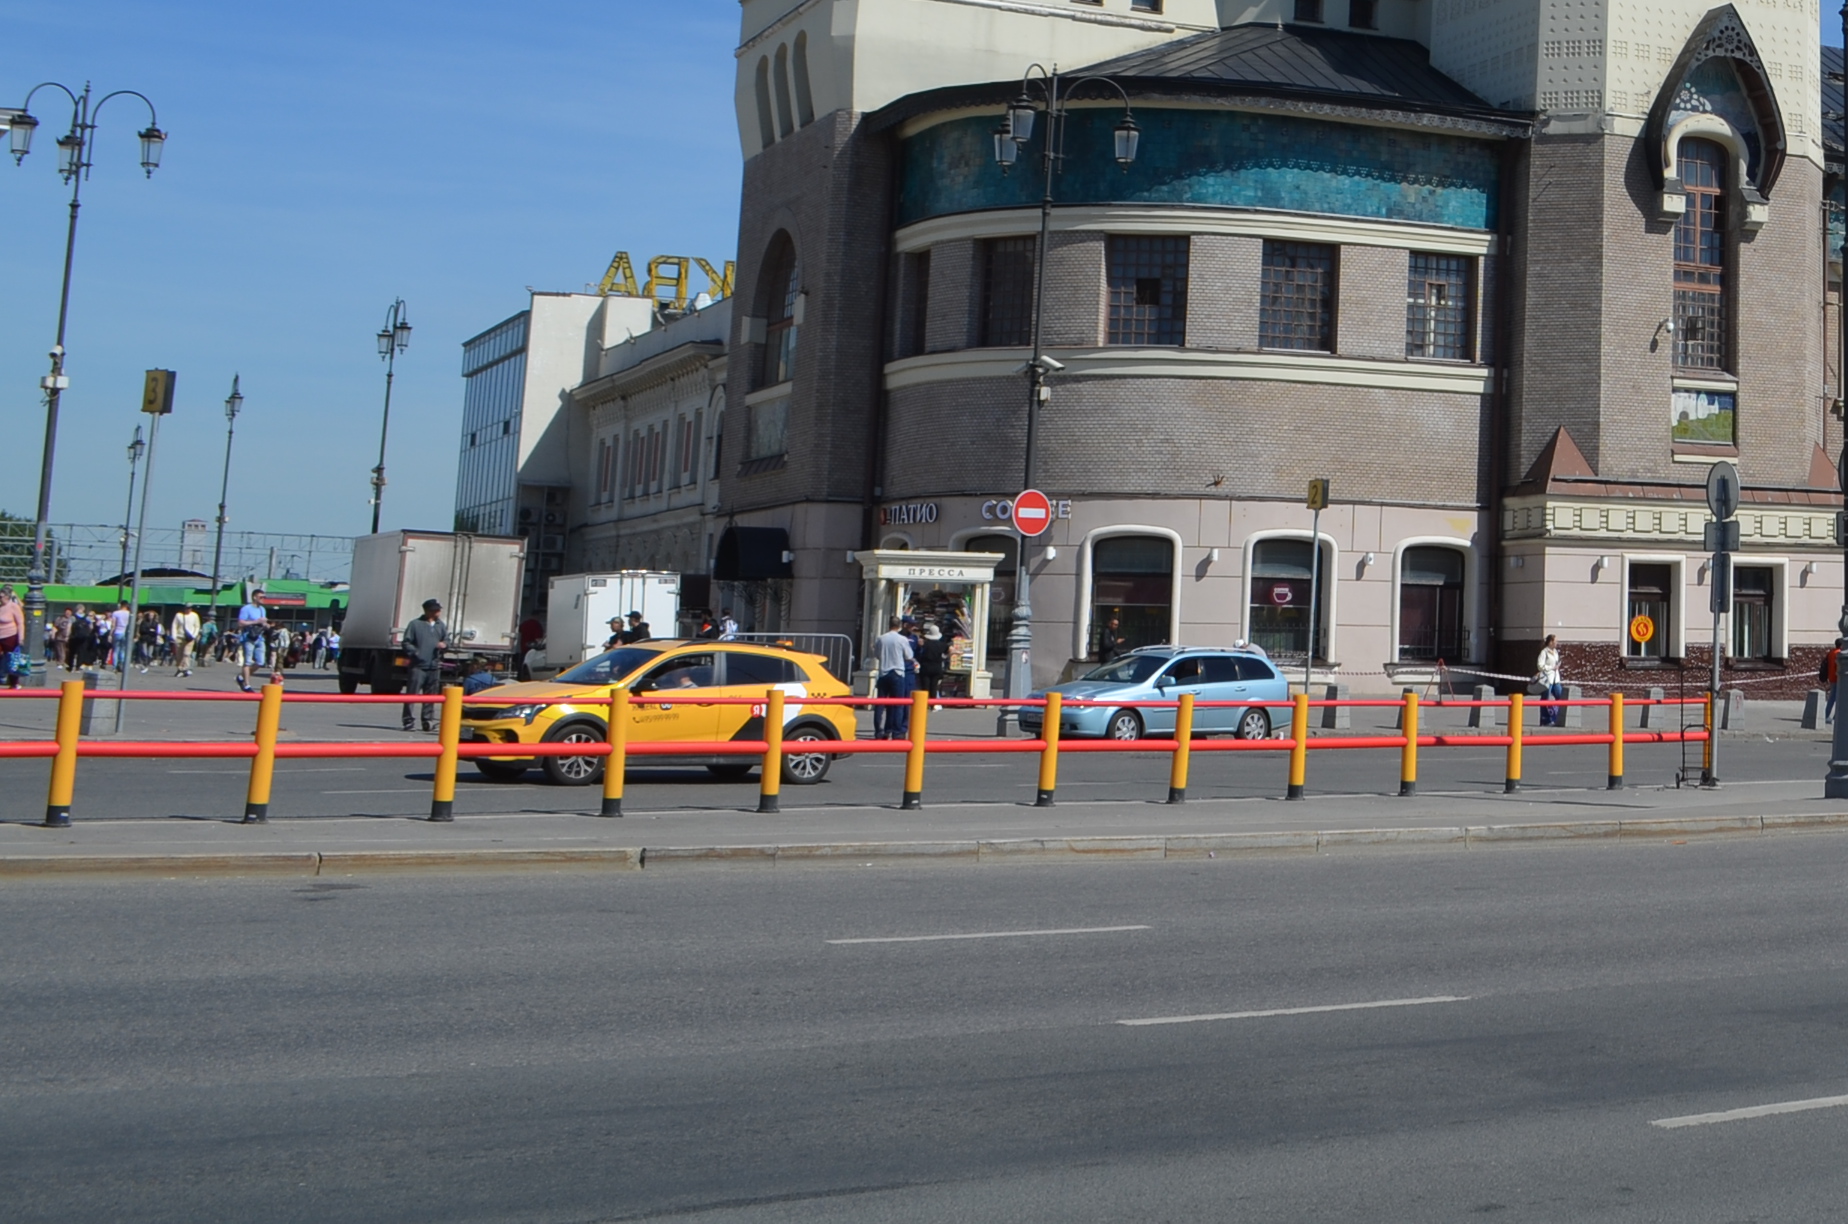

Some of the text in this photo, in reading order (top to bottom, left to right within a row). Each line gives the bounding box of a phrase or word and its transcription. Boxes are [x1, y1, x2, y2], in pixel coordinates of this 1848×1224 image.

[147, 376, 159, 405] 3
[1310, 484, 1319, 505] 2
[908, 568, 965, 577] ПРЕССА
